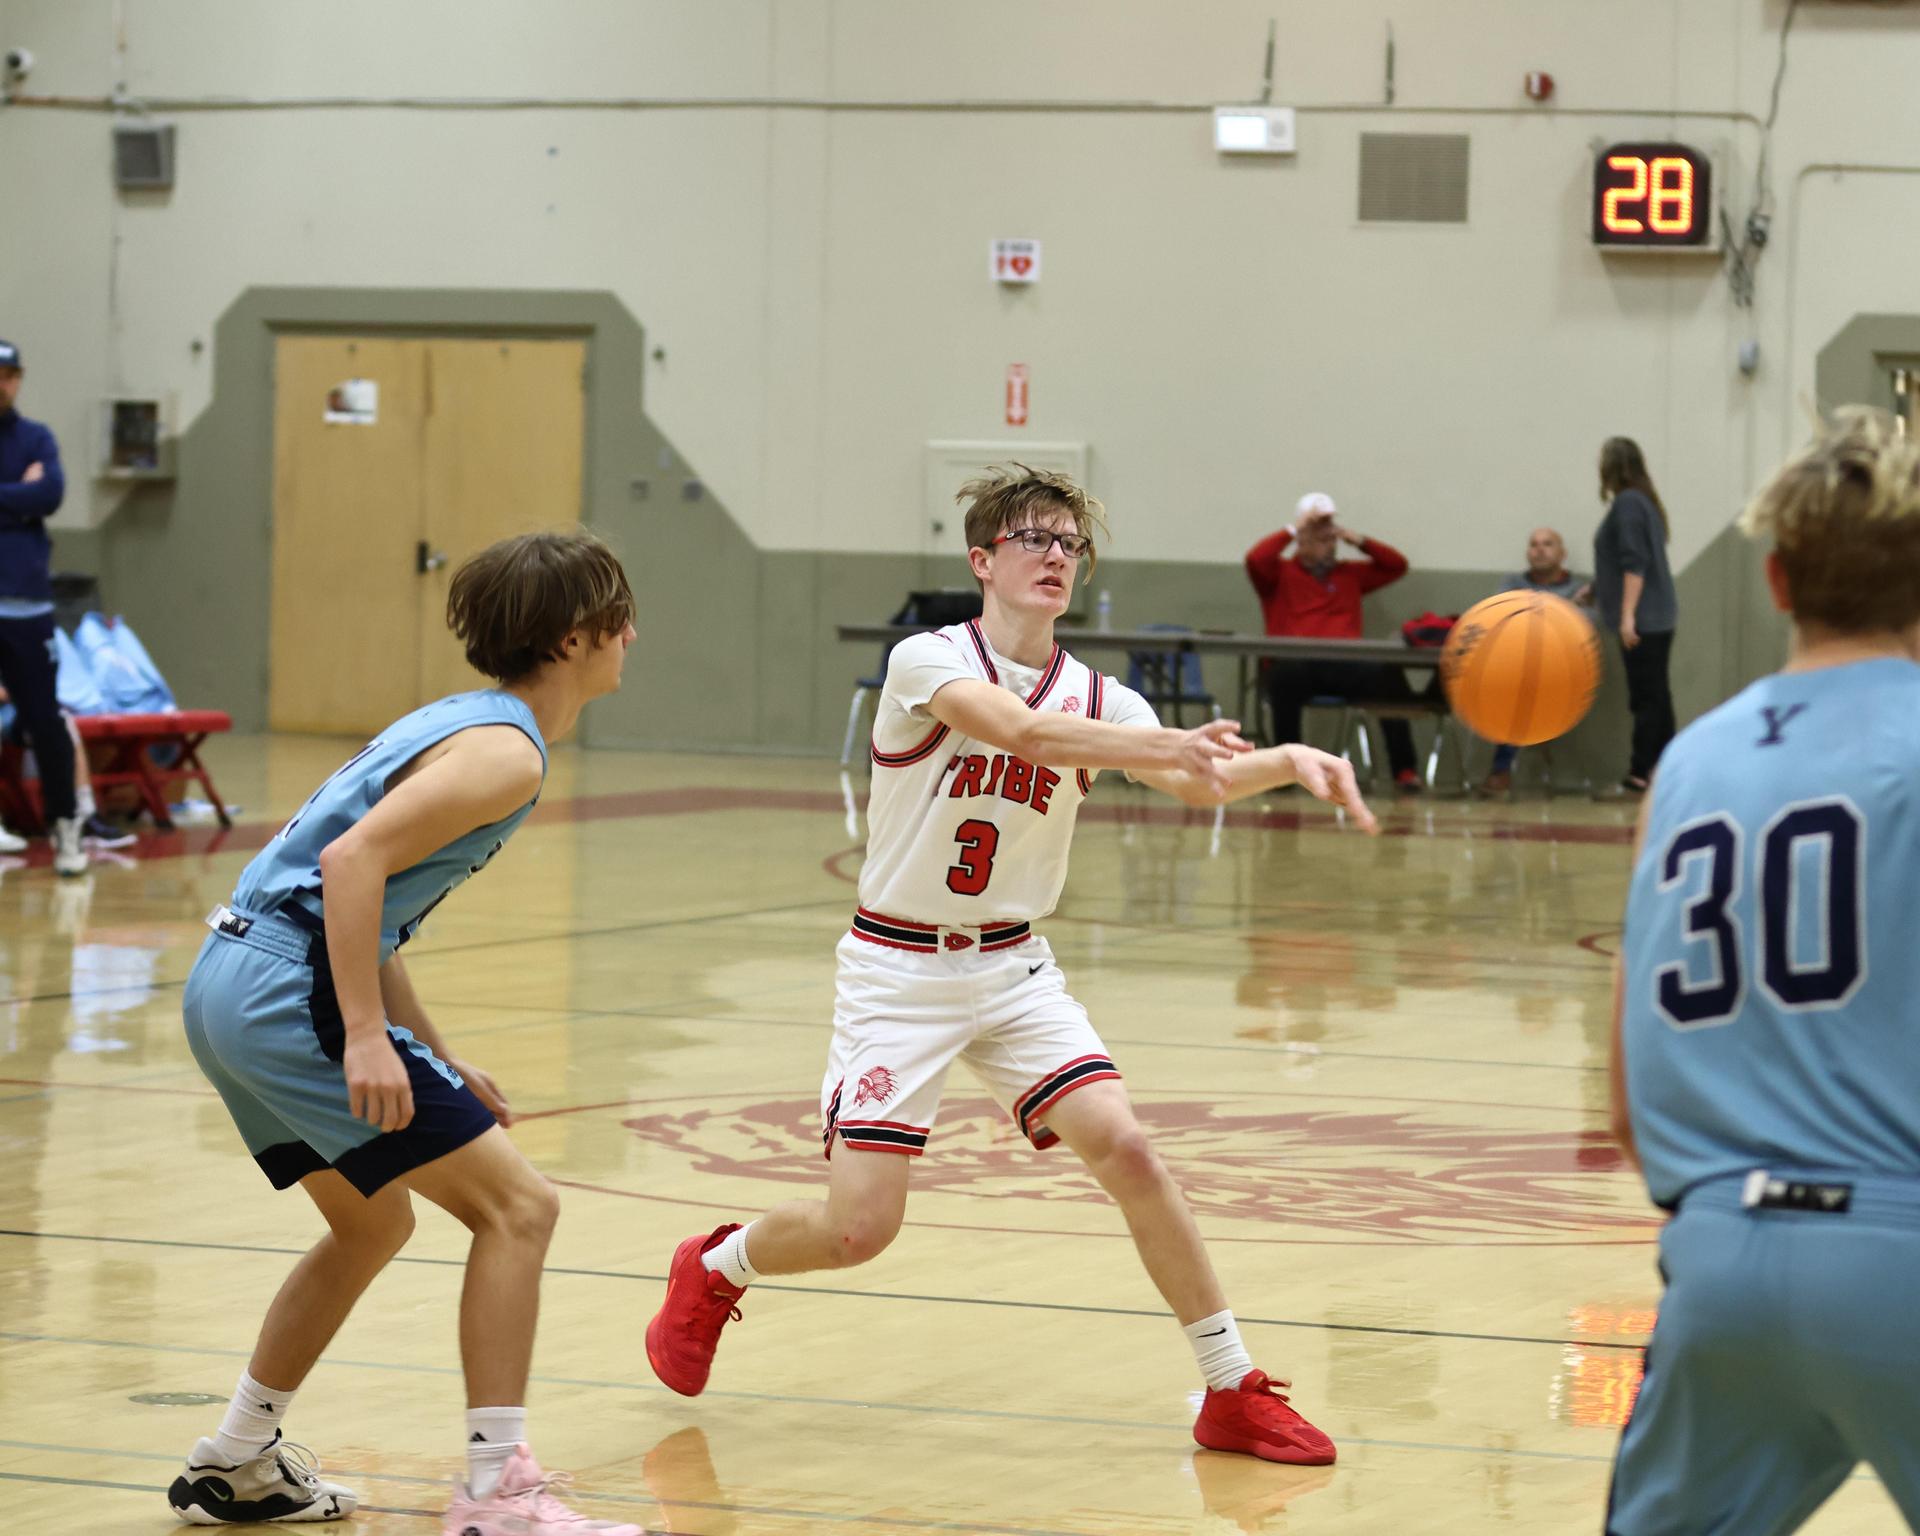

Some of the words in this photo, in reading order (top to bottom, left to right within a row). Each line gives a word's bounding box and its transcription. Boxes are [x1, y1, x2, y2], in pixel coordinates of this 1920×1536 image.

[1602, 156, 1694, 234] 28
[1756, 702, 1809, 748] Y
[946, 819, 1000, 896] 3
[1650, 794, 1868, 1032] 30
